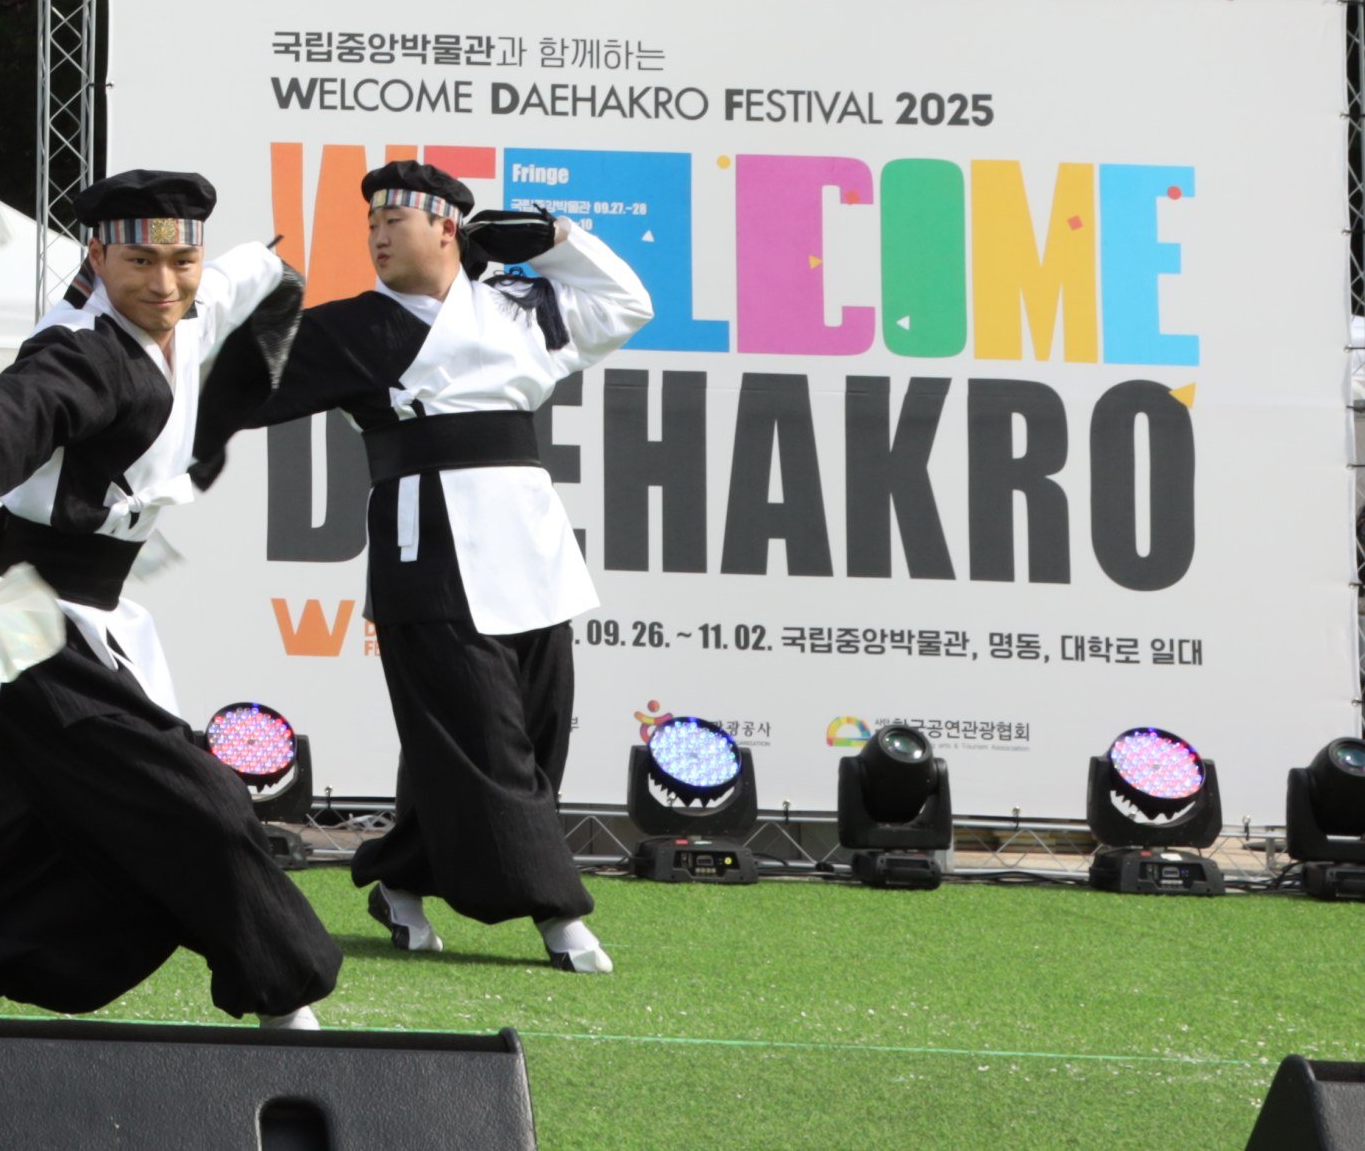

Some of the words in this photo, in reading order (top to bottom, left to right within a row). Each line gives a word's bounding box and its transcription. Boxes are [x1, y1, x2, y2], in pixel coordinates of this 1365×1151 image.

[272, 31, 527, 68] 국립중앙박물관과
[539, 37, 666, 72] 함께하는
[270, 77, 473, 114] WELCOME
[491, 82, 709, 120] DAEHAKRO
[724, 89, 883, 126] FESTIVAL
[895, 92, 995, 127] 2025
[512, 163, 569, 186] Fringe
[270, 142, 1200, 366] WLCOME
[267, 365, 1195, 592] DHAKRO
[587, 619, 626, 646] 09.
[632, 621, 670, 648] 26.
[699, 623, 728, 649] 11.
[735, 624, 773, 651] 02.
[781, 626, 979, 661] 국립중앙박물관,
[988, 633, 1051, 665] 명동,
[1061, 634, 1141, 665] 대학로
[1150, 638, 1204, 667] 일대
[893, 718, 1030, 741] 공연관광협회
